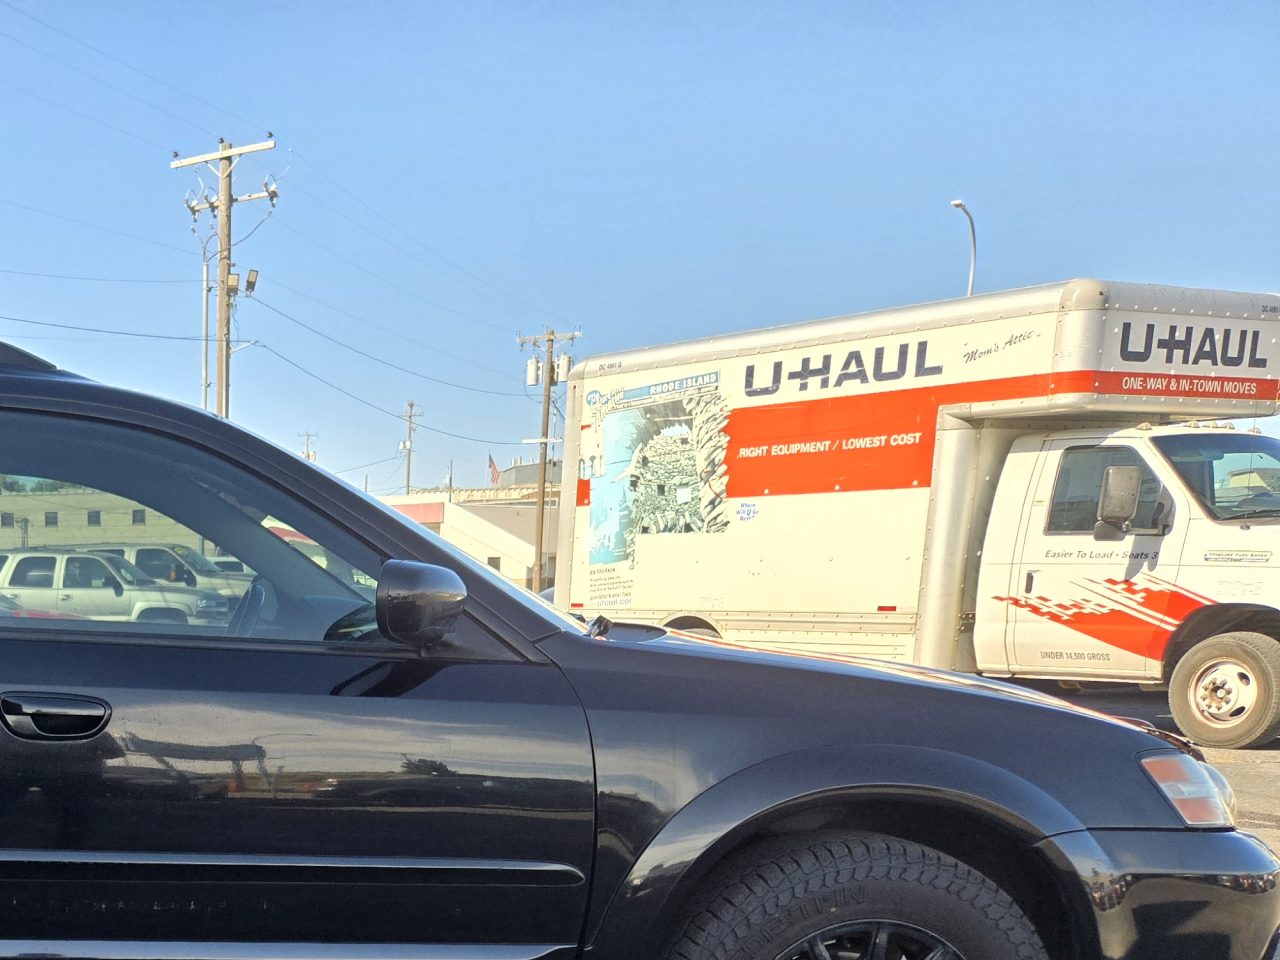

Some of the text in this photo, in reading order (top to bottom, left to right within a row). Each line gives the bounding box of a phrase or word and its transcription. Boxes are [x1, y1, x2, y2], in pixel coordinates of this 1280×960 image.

[963, 330, 1035, 364] Mom's Attic
[1120, 322, 1268, 368] U-HAUL
[744, 340, 943, 397] U-HAUL
[649, 373, 718, 395] RHODE ISLAND
[1122, 376, 1257, 394] ONE-WAY & IN-TOWN MOVES
[739, 432, 922, 458] RIGHT EQUIPMENT / LOWEST COST
[1045, 550, 1159, 560] Easier To Load Seats 3
[1040, 651, 1111, 661] UNDER 14,500 GROSS
